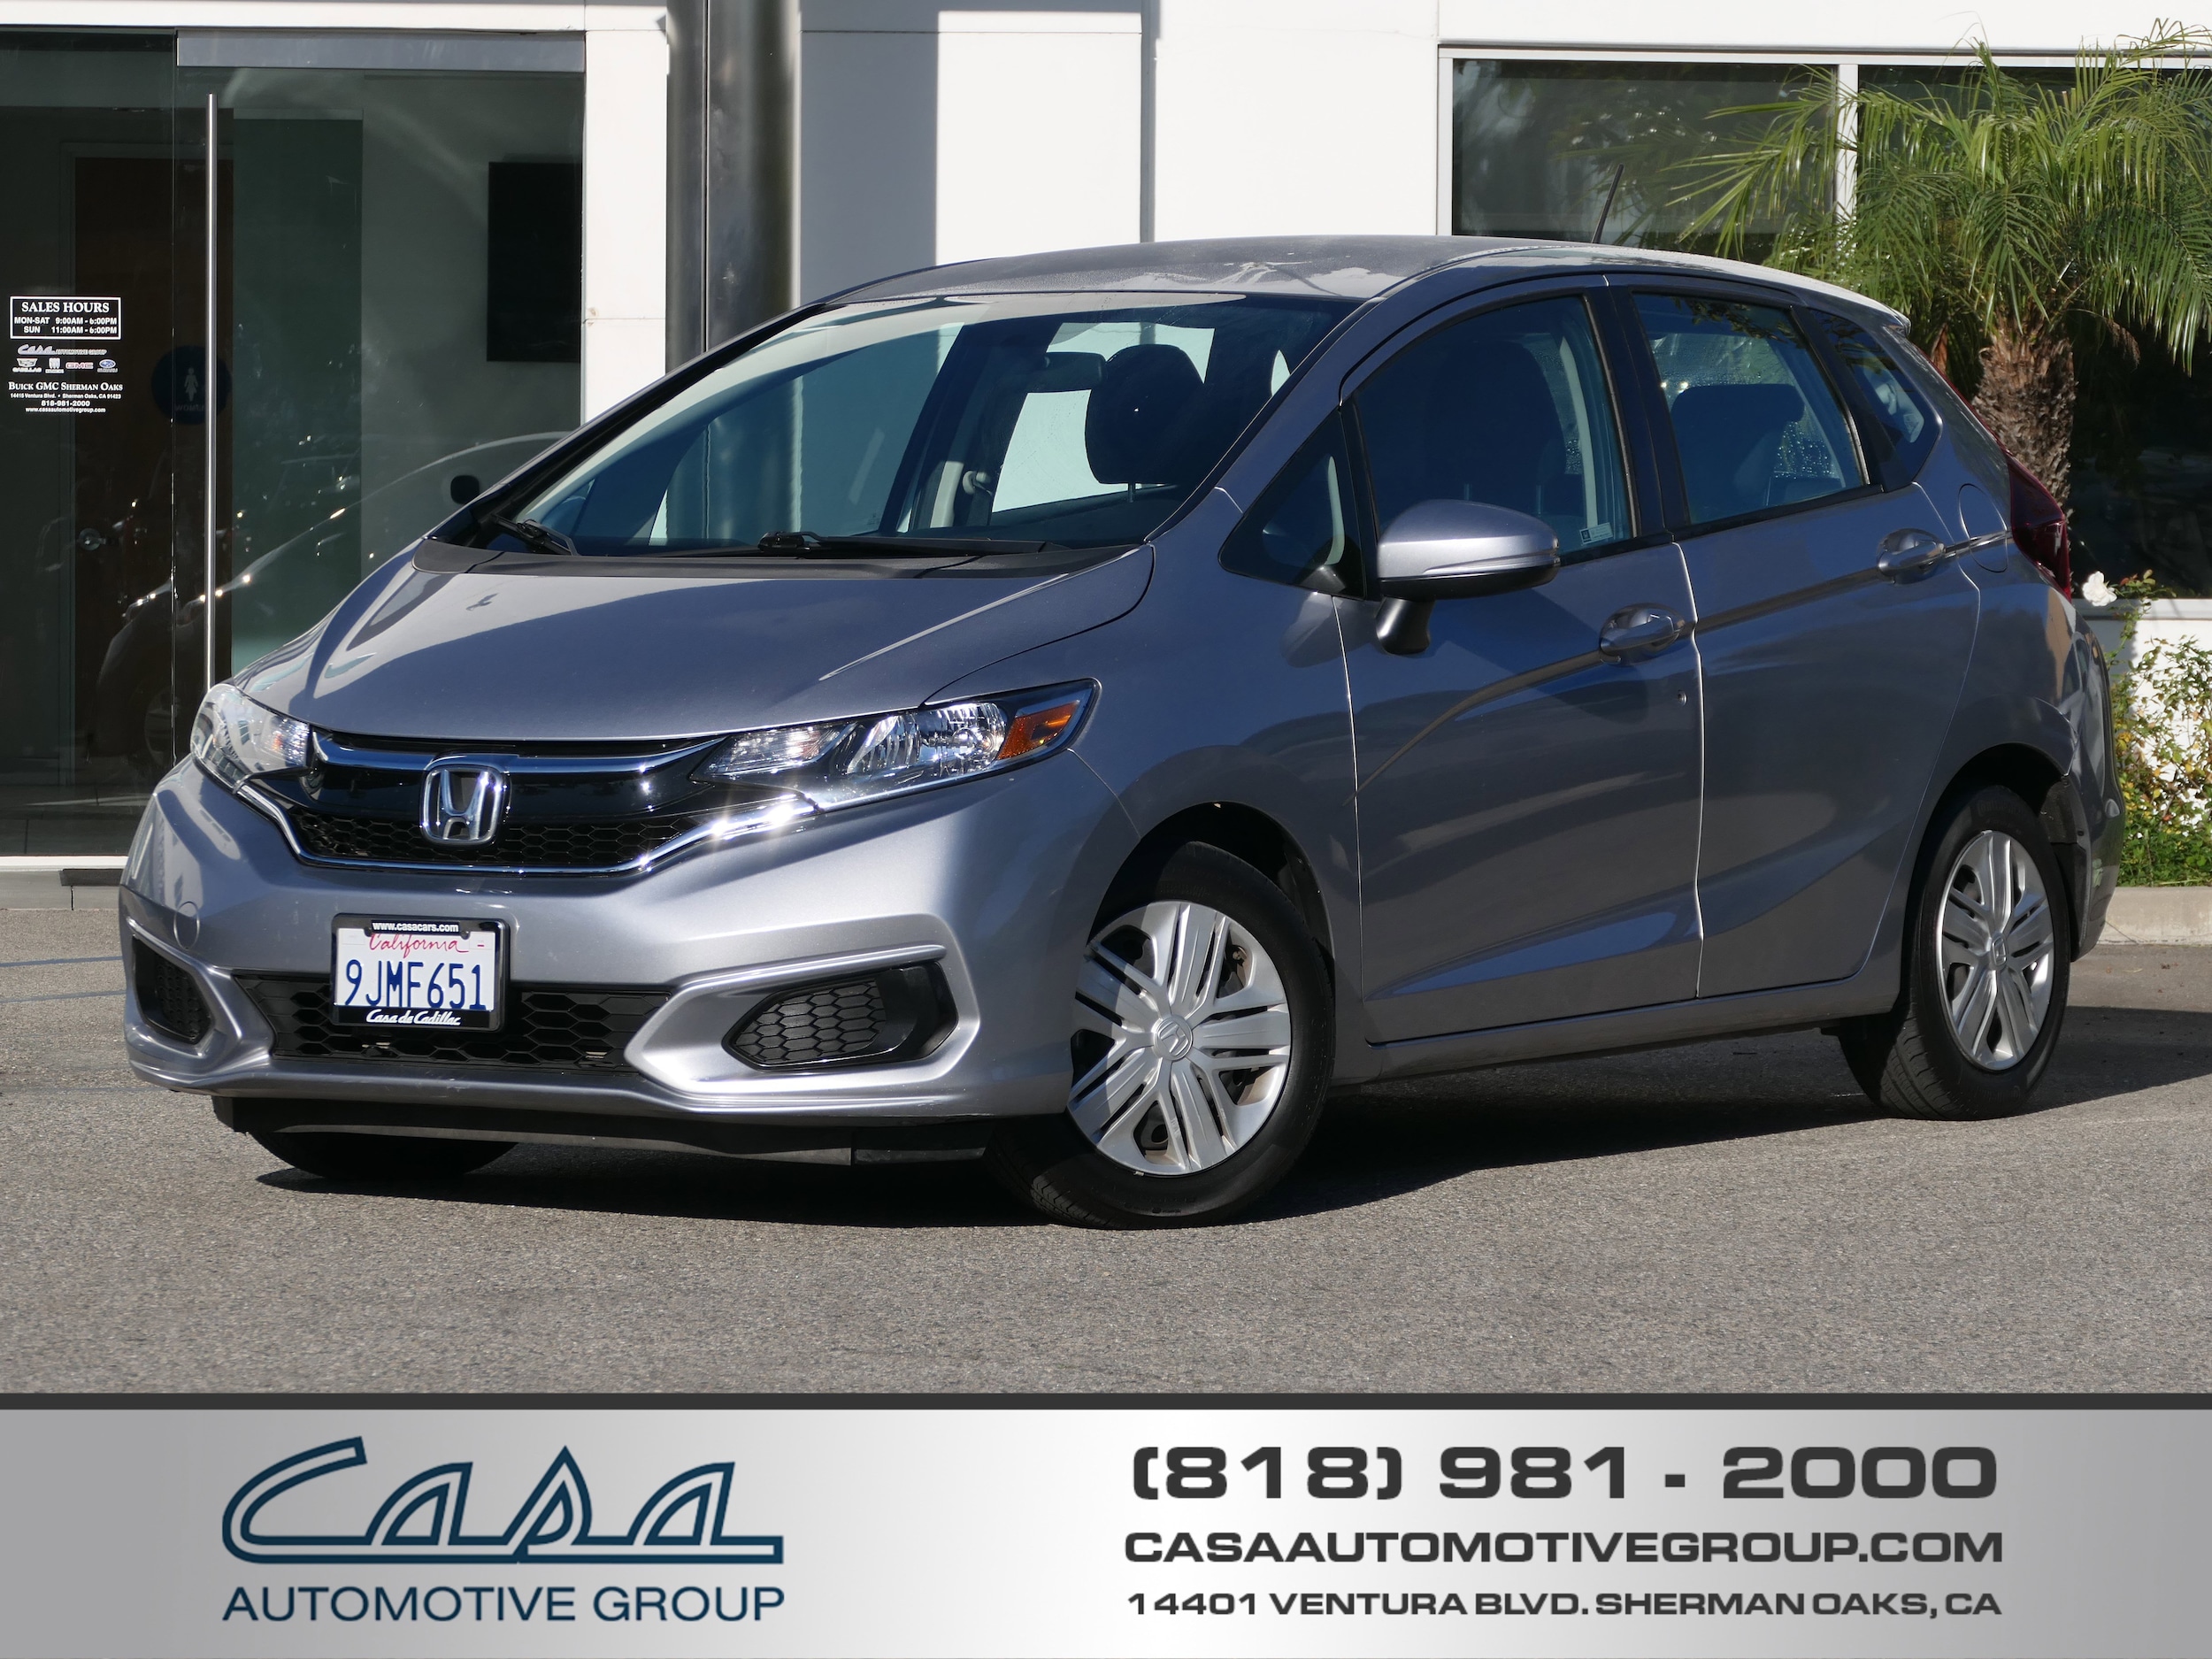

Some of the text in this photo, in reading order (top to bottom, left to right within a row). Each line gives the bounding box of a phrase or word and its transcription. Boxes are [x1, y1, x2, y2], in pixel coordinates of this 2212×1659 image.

[21, 301, 110, 313] SALES HOURS
[14, 316, 50, 325] MON-SAT
[88, 317, 118, 326] 6:00PM
[23, 325, 41, 334] SUN
[50, 326, 84, 334] 11:00AM
[88, 326, 118, 334] 6:00PM
[35, 381, 59, 391] GMC
[372, 922, 459, 933] www.casacars.com
[369, 933, 469, 959] California
[345, 958, 487, 1010] 9JMF651
[365, 1009, 461, 1026] Casa de Cadillac
